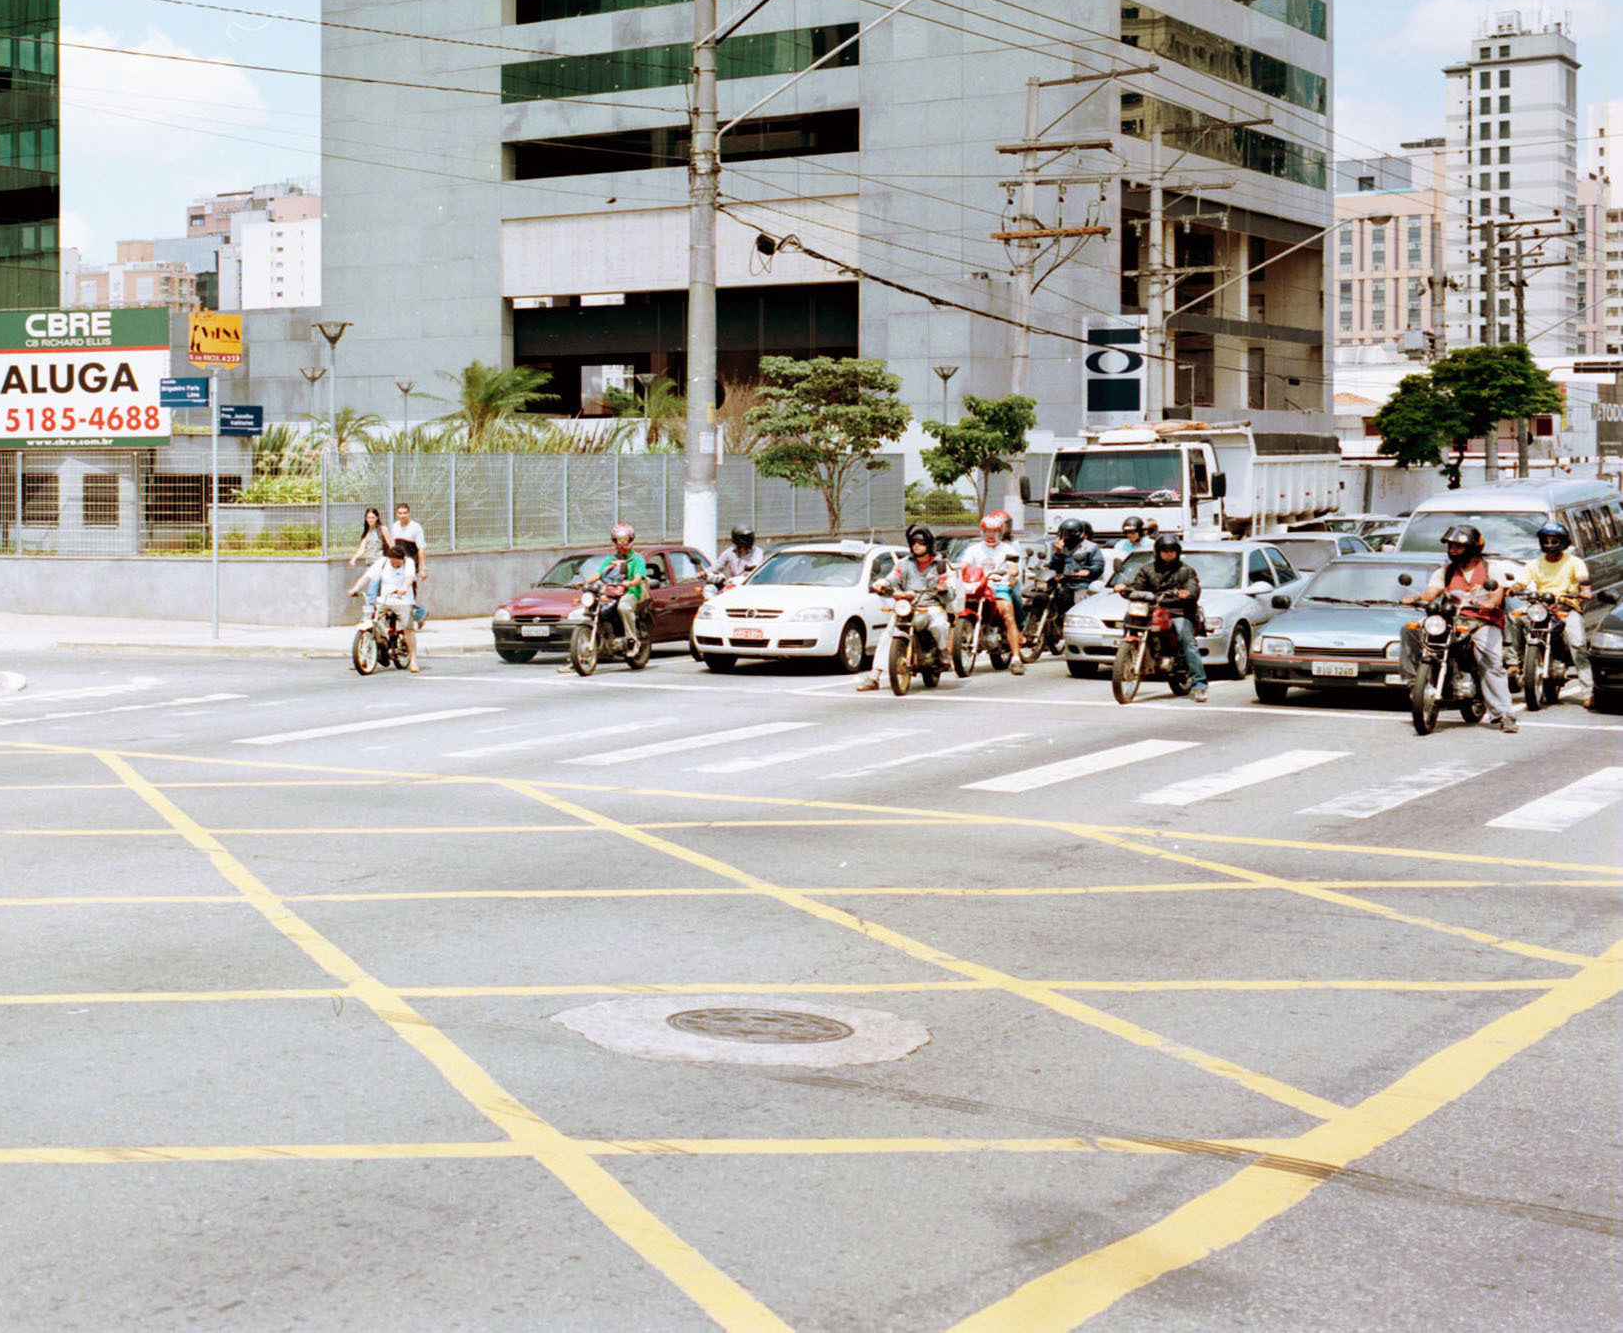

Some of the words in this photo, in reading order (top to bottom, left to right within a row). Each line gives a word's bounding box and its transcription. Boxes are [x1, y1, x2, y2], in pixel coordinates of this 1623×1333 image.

[25, 311, 112, 337] CBRE
[25, 339, 39, 347] CB
[41, 338, 84, 347] RICHARD
[86, 337, 112, 346] ELLIS
[0, 362, 139, 394] ALUGA
[5, 405, 160, 432] 5185-4688
